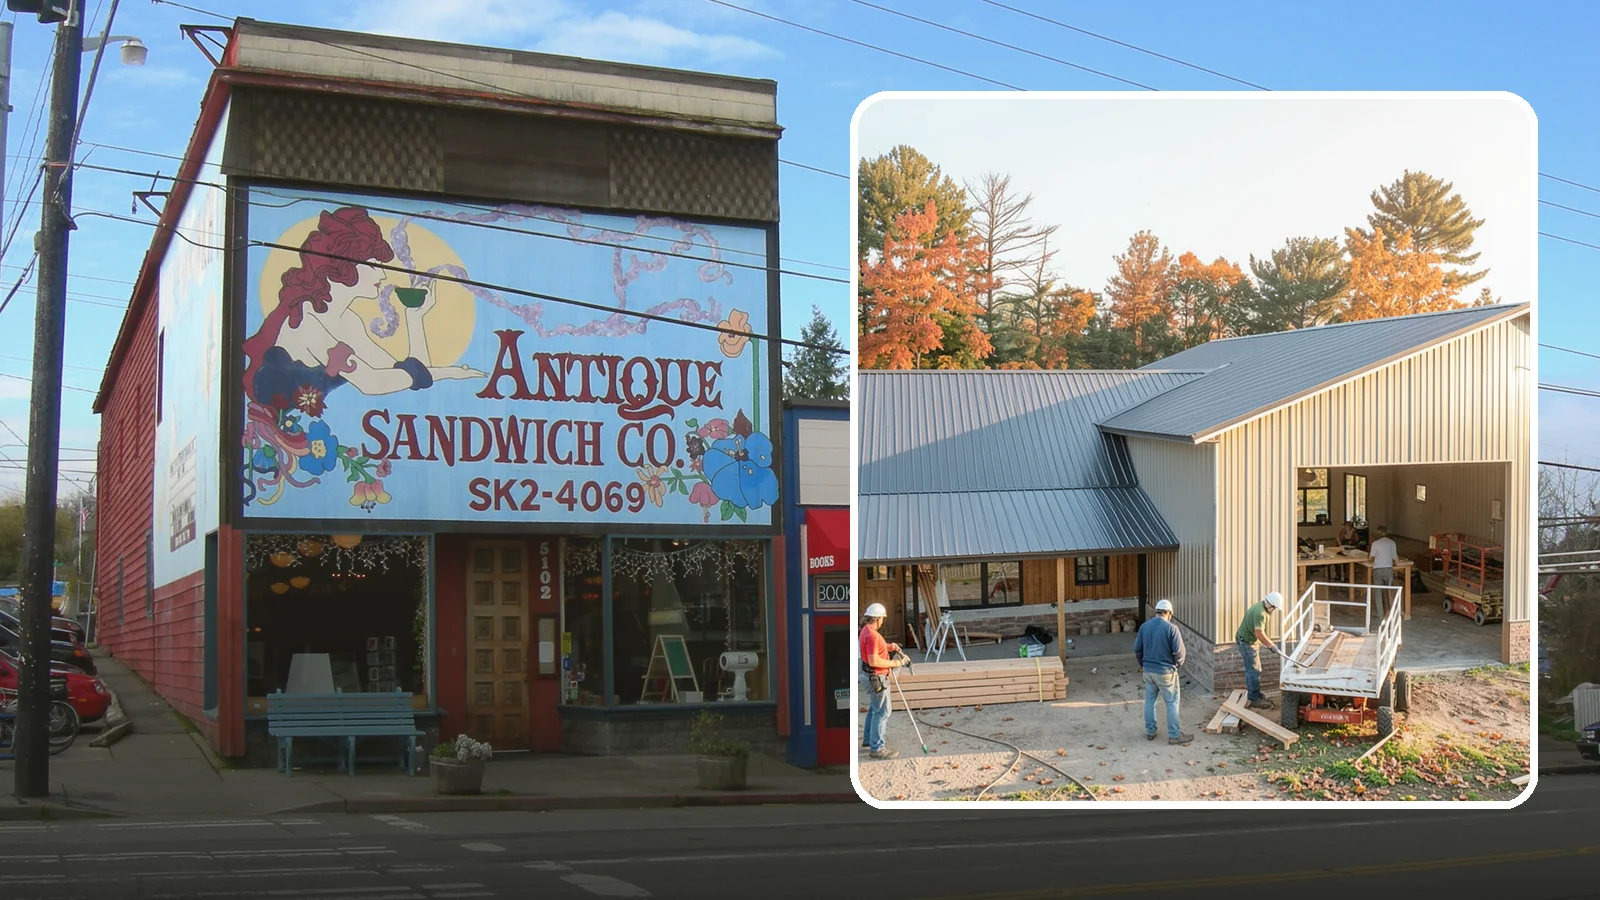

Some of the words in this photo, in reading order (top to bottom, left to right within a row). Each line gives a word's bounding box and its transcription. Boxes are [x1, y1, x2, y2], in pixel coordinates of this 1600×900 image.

[475, 330, 723, 420] ANTIQUE
[361, 409, 604, 467] SANDWICH
[616, 423, 685, 468] CO.
[469, 478, 645, 512] SK2-4069
[539, 542, 551, 599] 5102
[809, 555, 835, 569] BOOKS
